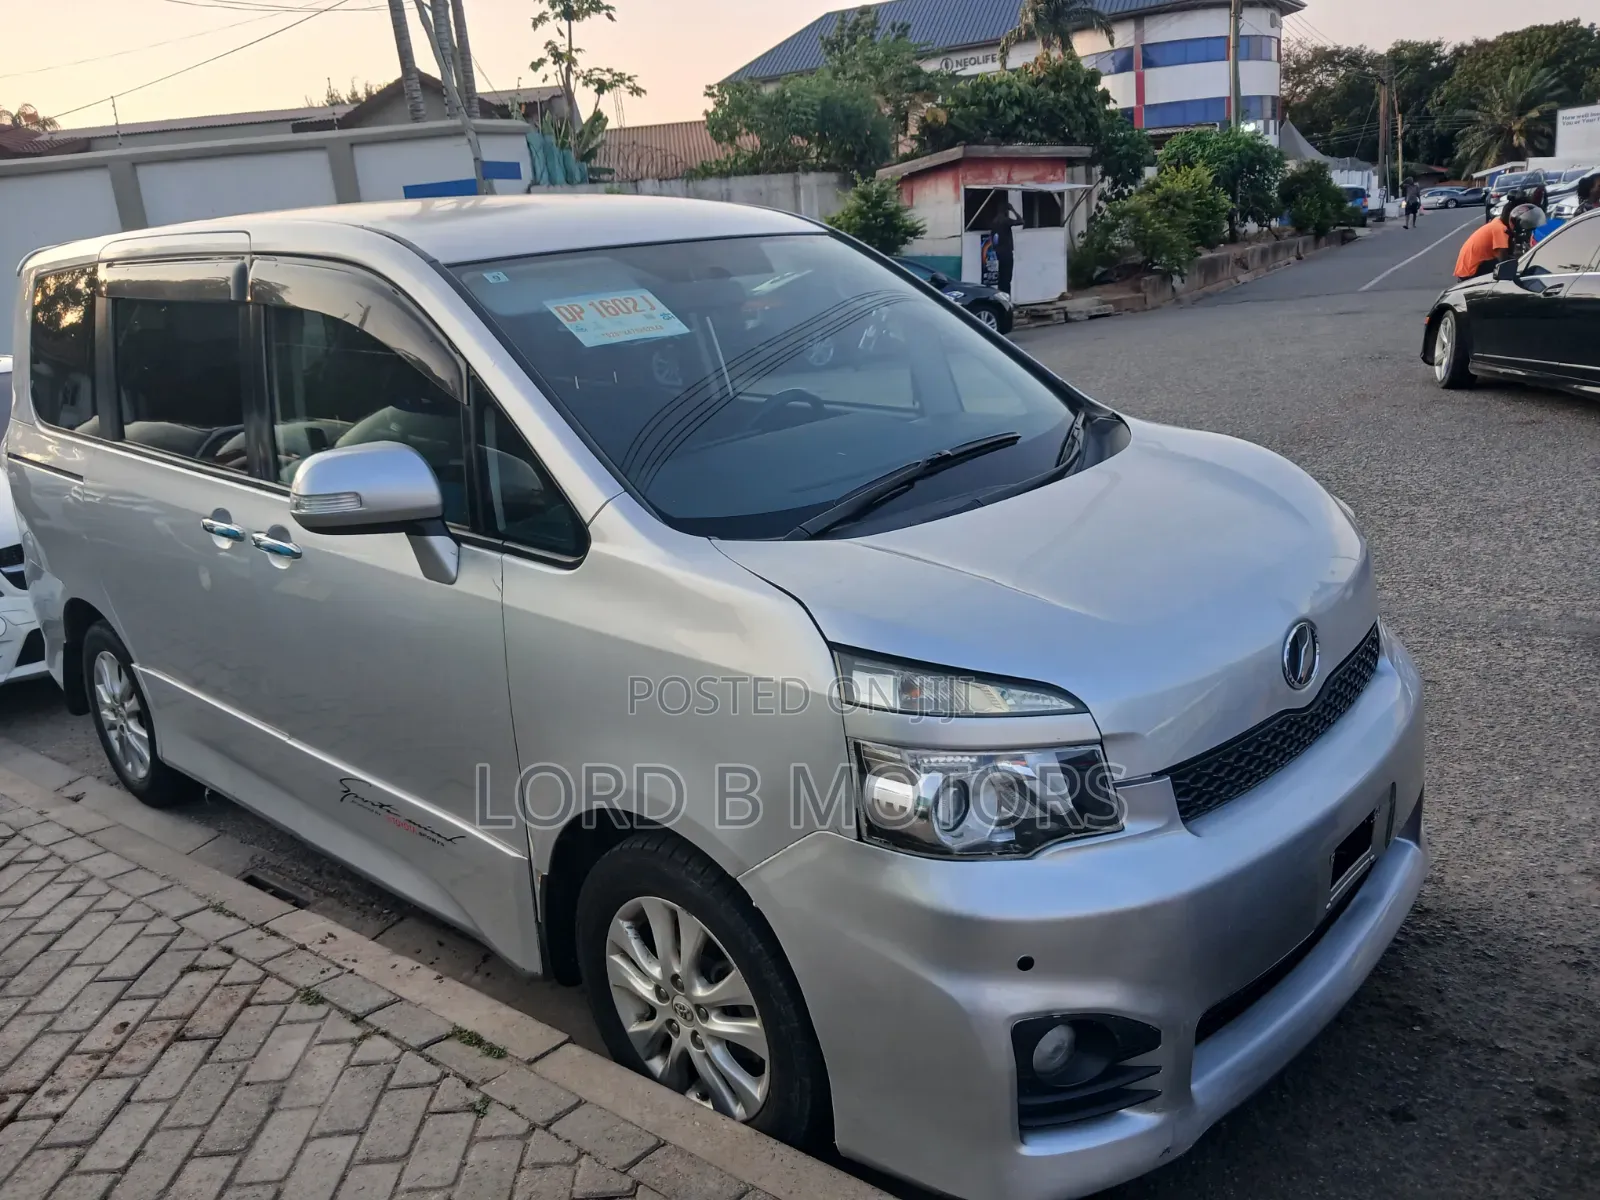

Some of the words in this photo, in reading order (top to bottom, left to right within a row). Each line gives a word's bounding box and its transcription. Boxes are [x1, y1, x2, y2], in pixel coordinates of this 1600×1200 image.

[955, 53, 997, 68] NEOLIFE
[554, 303, 586, 323] DP
[588, 297, 646, 319] 1602
